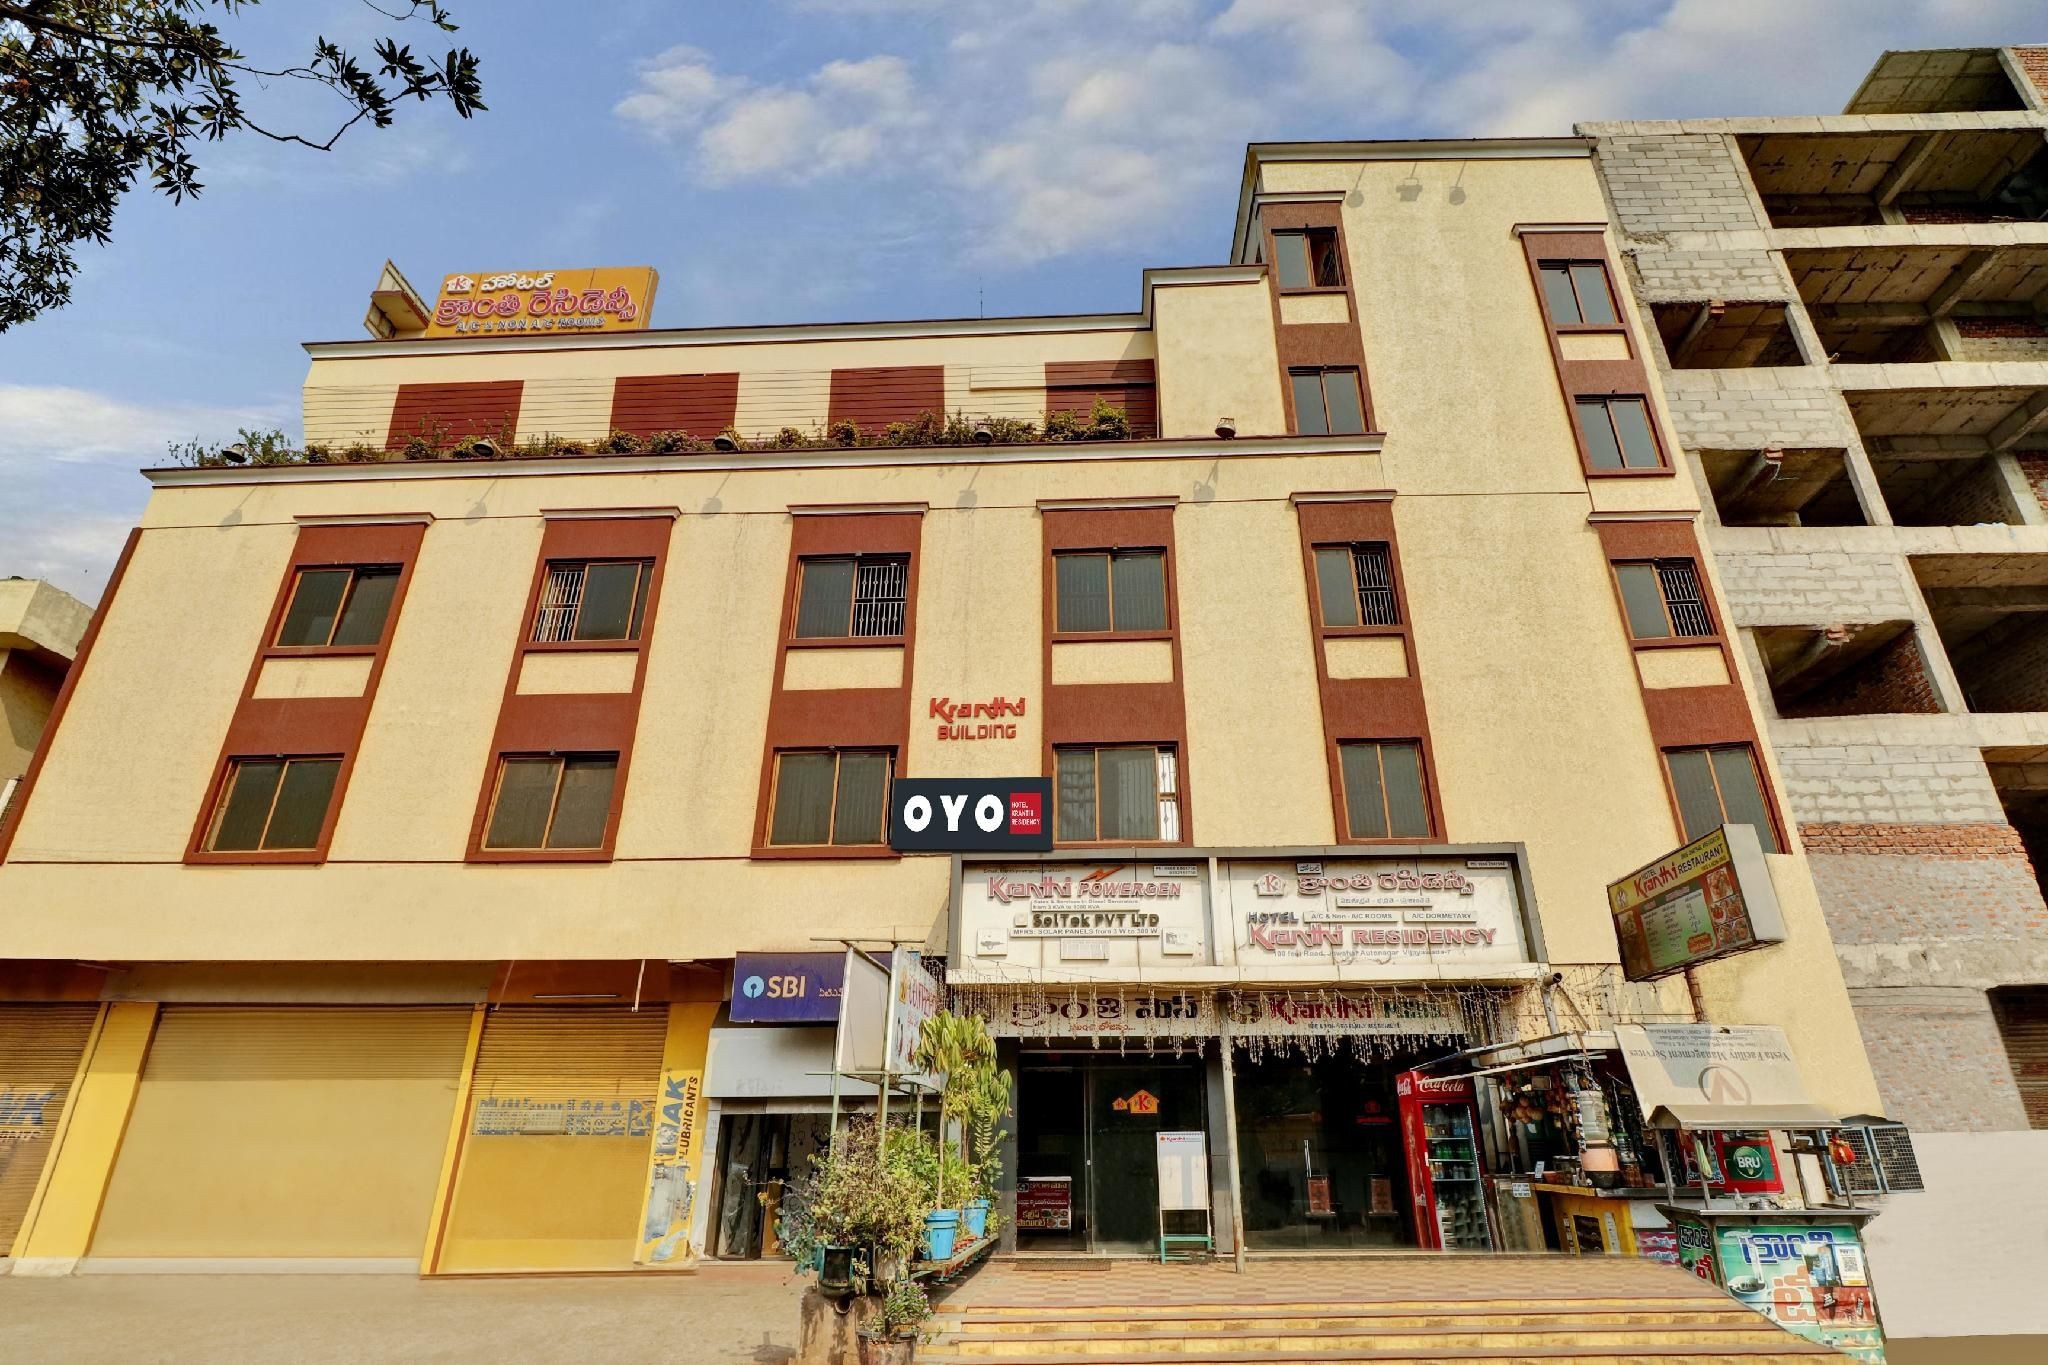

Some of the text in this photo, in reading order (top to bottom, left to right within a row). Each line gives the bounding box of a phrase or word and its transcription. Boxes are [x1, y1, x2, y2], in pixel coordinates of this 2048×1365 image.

[436, 293, 521, 325] క్రాంతి
[497, 318, 527, 330] NON
[558, 316, 605, 329] ROOMS
[929, 697, 1026, 723] Kranthi
[903, 794, 1004, 832] OYO
[1011, 818, 1041, 826] RESIDENCY
[1634, 863, 1678, 898] Kranthi
[1678, 843, 1724, 875] RESTAURANT
[1640, 868, 1657, 880] HOTEL
[988, 876, 1183, 902] Kranthi POWERGEN
[1298, 874, 1373, 895] క్రాంతి
[1095, 913, 1127, 928] PVT
[1132, 913, 1160, 927] LTD
[1248, 912, 1299, 924] HOTEL
[1250, 923, 1497, 950] Kranthi RESIDENCY
[767, 975, 806, 998] SBI
[1629, 1049, 1666, 1060] Services
[1668, 1049, 1726, 1061] Management
[1730, 1050, 1763, 1061] Facility
[678, 1076, 698, 1156] LUBRICANTS
[1737, 1156, 1760, 1168] BRU
